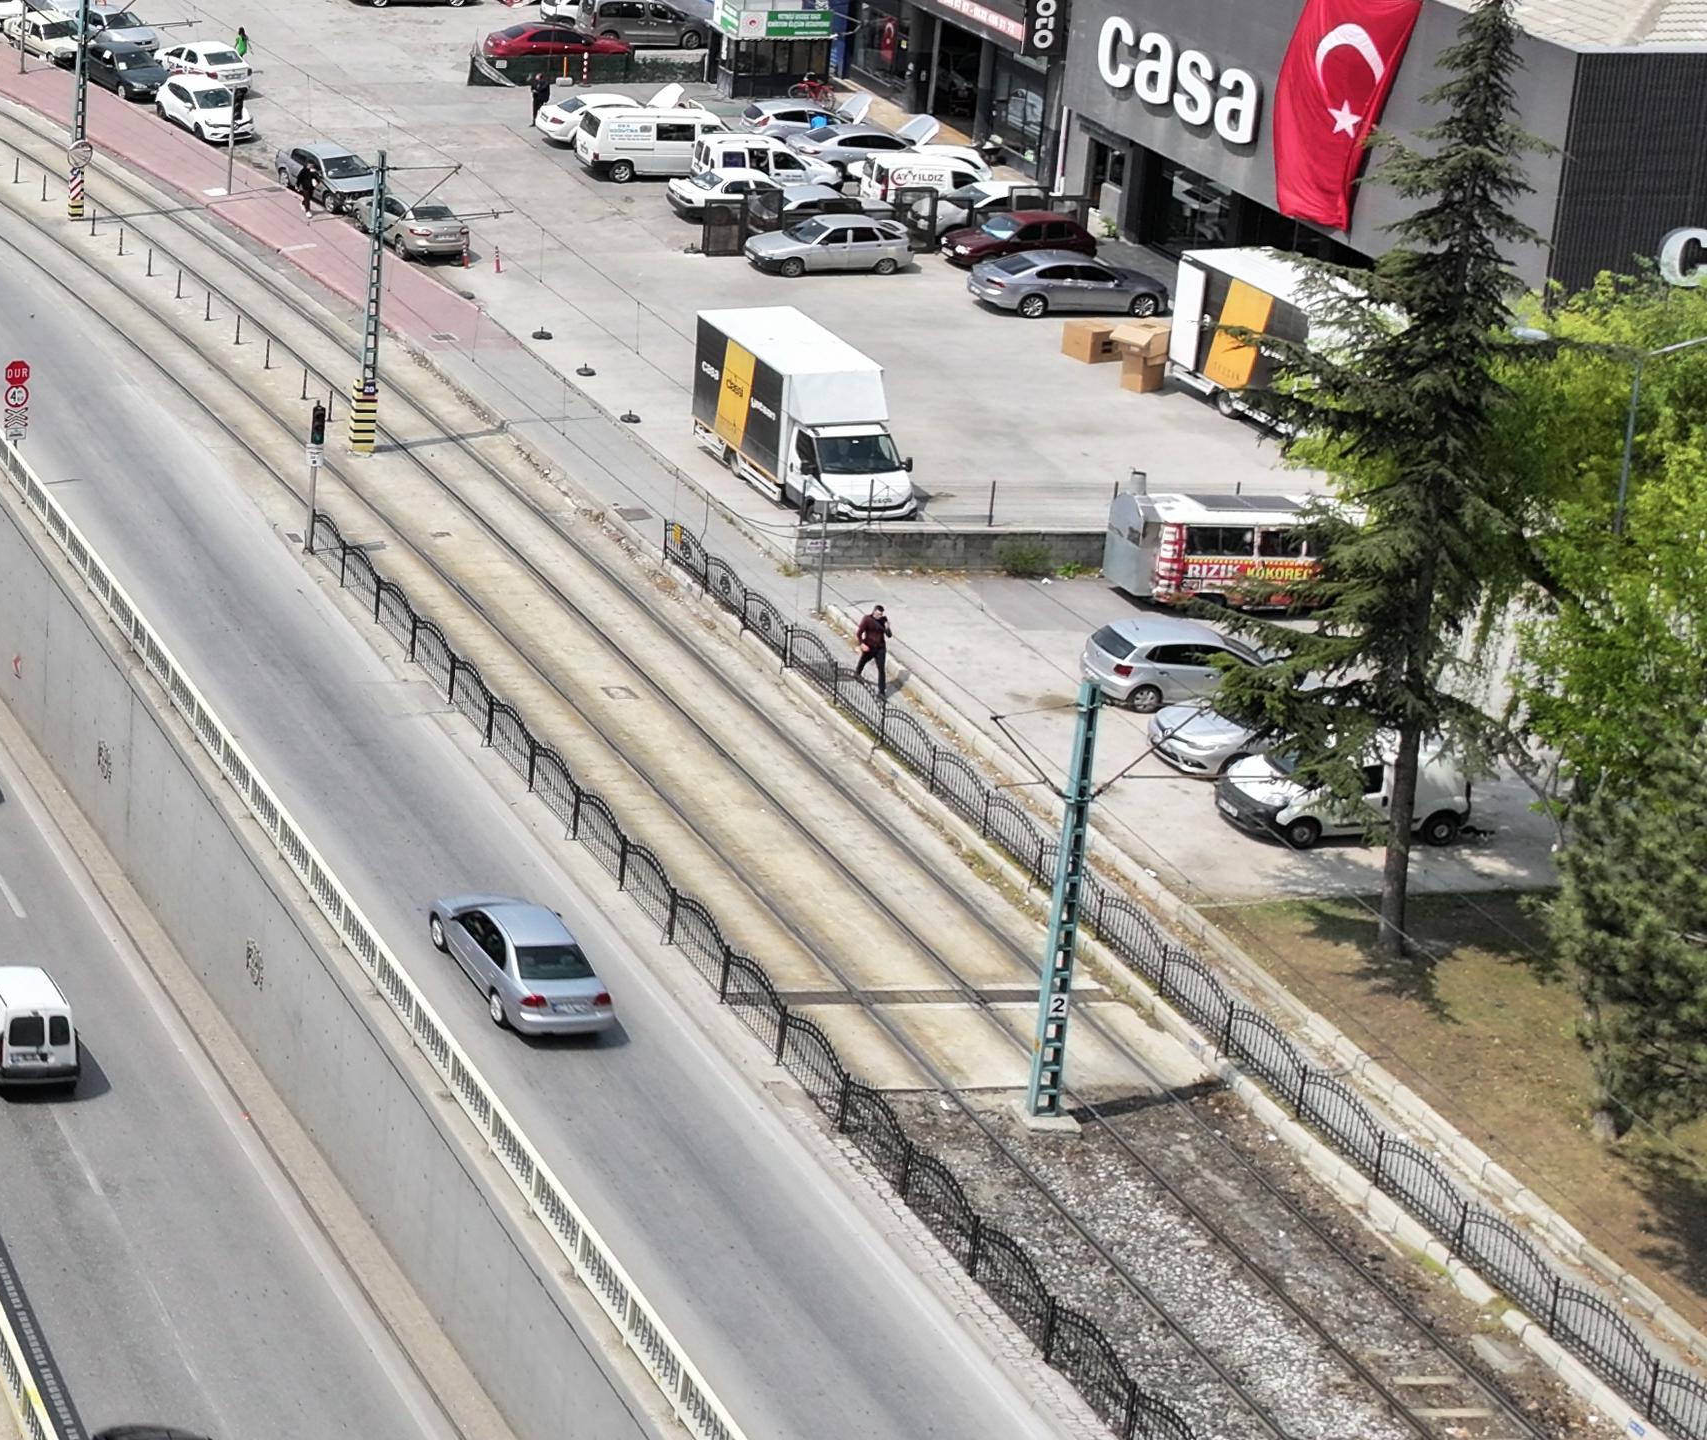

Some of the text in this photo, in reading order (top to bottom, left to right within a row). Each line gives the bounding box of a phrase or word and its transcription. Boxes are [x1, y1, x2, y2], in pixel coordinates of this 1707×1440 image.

[1096, 15, 1261, 146] casa
[910, 172, 944, 183] YILDIZ
[7, 367, 28, 379] DUR
